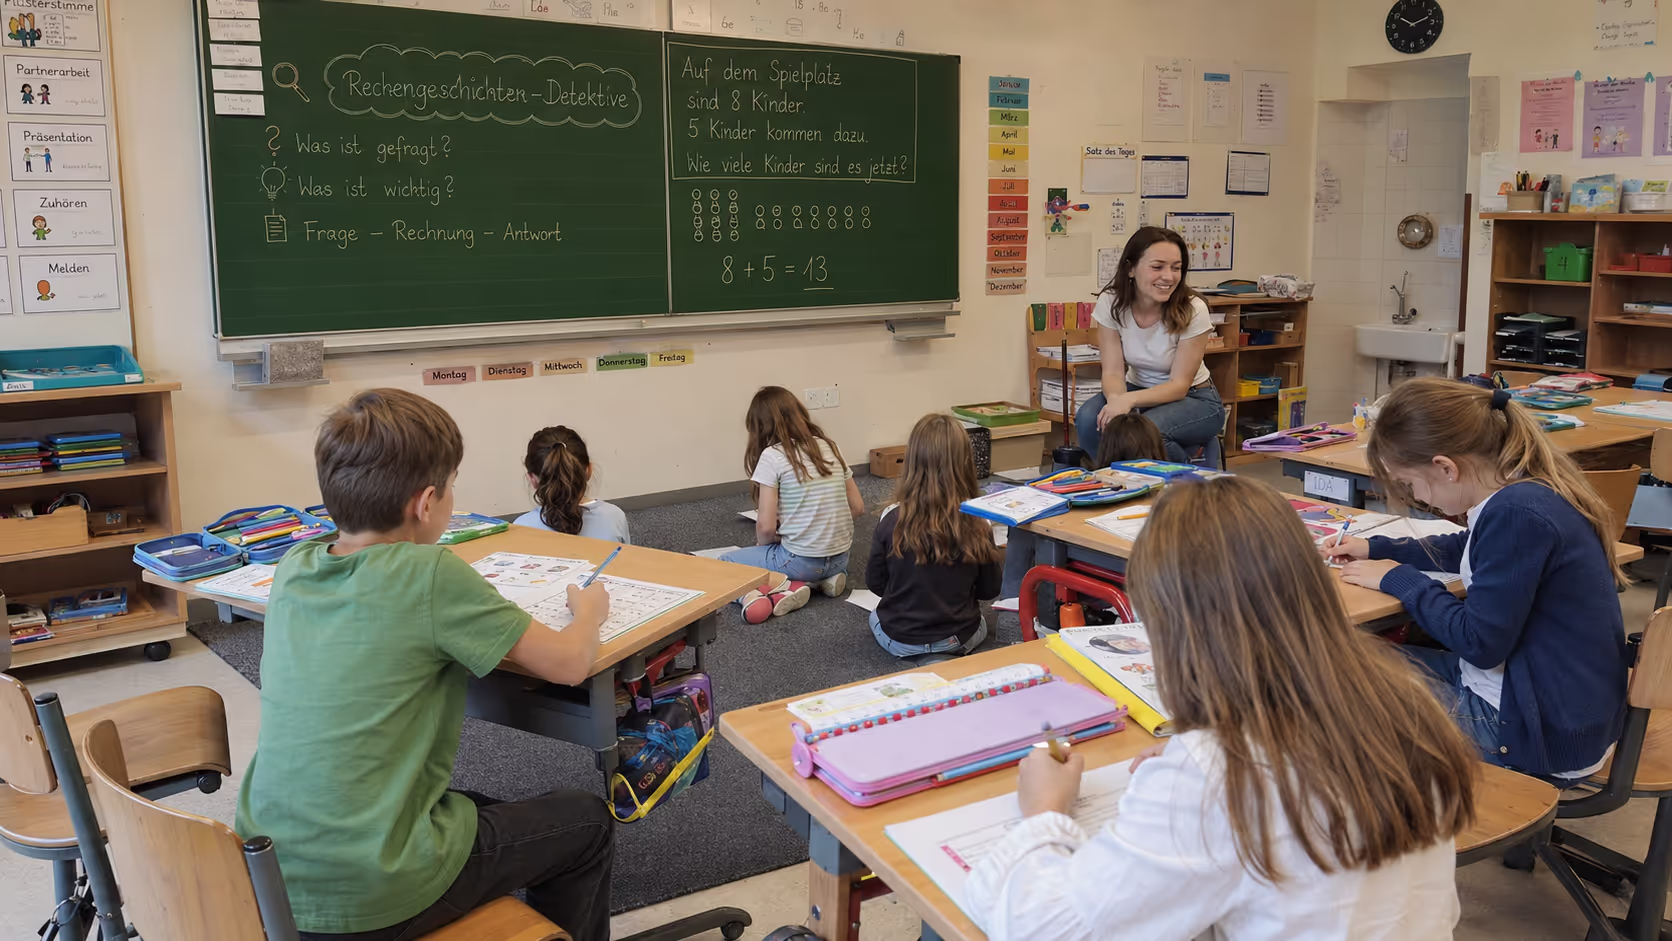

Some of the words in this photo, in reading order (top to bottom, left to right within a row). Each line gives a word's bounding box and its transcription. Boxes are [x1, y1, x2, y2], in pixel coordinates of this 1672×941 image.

[16, 63, 91, 78] Partnerarbeit
[681, 56, 713, 86] Auf
[723, 58, 758, 82] dem
[769, 59, 842, 91] Spielplatz
[687, 88, 720, 111] sind
[731, 89, 741, 111] 8
[23, 130, 94, 143] Präsentation
[688, 117, 700, 139] 5
[710, 118, 757, 141] Kinder
[766, 119, 823, 142] kommen
[833, 122, 869, 144] dazu.
[1000, 130, 1018, 140] April
[295, 133, 331, 154] Was
[340, 135, 362, 155] ist
[1002, 147, 1016, 156] Mai
[1086, 146, 1102, 155] Satz
[1104, 147, 1116, 156] des
[1117, 147, 1136, 158] Tages
[686, 151, 711, 174] Wie
[721, 151, 753, 174] viele
[764, 153, 806, 175] Kinder
[814, 155, 840, 175] sind
[847, 163, 862, 175] es
[864, 154, 908, 185] jetzt?
[1001, 164, 1016, 173] Juni
[298, 175, 333, 198] Was
[346, 176, 368, 197] ist
[39, 196, 88, 209] Zuhören
[303, 220, 358, 250] Frage
[392, 219, 475, 249] Rechnung
[503, 222, 562, 242] Antwort
[48, 263, 90, 274] Melden
[721, 255, 734, 284] 8
[762, 254, 776, 282] 5
[803, 255, 829, 282] 13
[1557, 255, 1568, 273] 4
[990, 266, 1024, 276] November
[989, 282, 1024, 291] Dezember
[598, 357, 646, 367] Donnerstag
[658, 353, 686, 363] Freitag
[488, 366, 527, 376] Dienstag
[544, 360, 583, 371] Mittwoch
[432, 370, 467, 381] Montag
[1313, 476, 1333, 493] IDA
